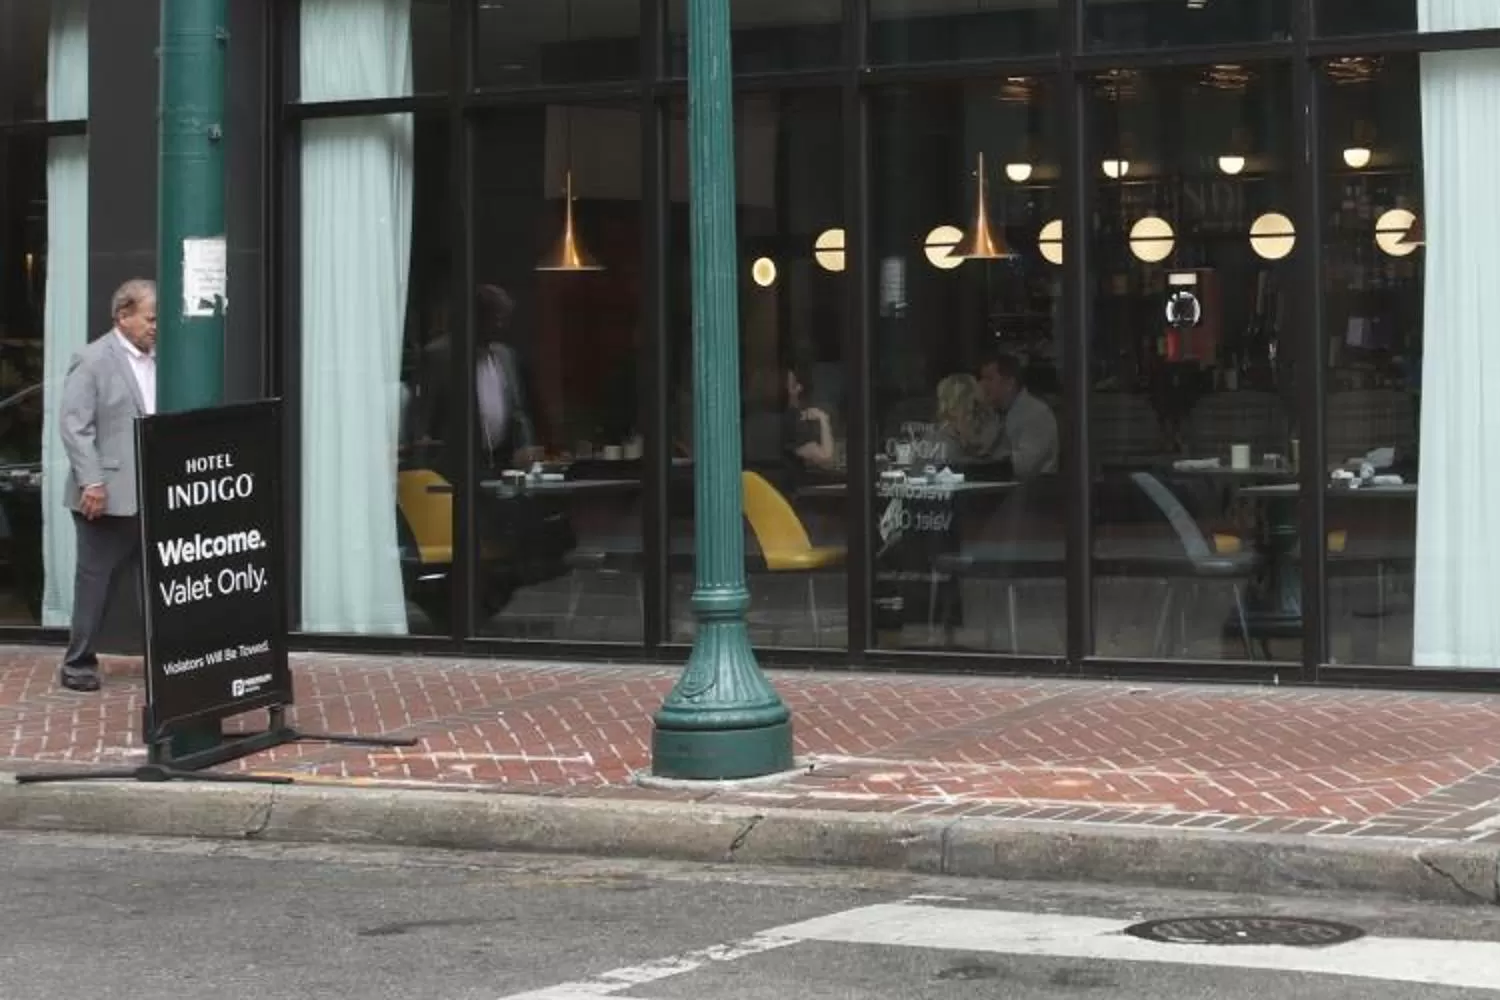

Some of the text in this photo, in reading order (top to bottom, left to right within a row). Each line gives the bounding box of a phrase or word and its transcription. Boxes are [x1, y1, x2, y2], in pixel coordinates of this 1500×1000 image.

[185, 453, 234, 473] HOTEL
[167, 473, 253, 510] INDIGO
[157, 529, 267, 567] Welcome.
[159, 563, 267, 607] Valet Only.
[163, 658, 205, 676] Violators
[205, 649, 223, 665] Will
